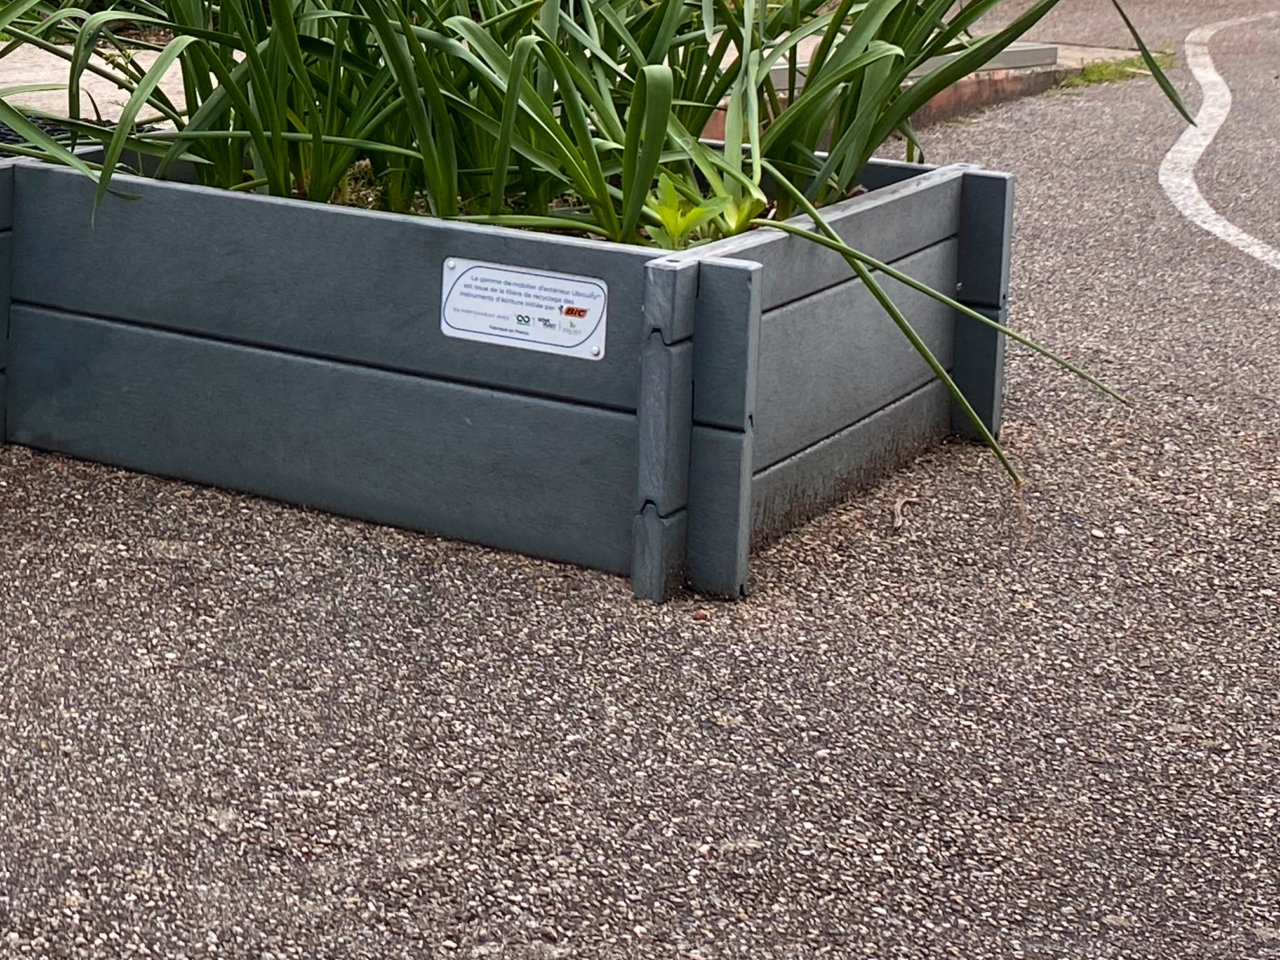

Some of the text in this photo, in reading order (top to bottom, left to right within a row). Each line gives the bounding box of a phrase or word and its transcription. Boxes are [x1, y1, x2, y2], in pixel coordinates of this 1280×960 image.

[480, 277, 502, 285] gamme
[512, 281, 536, 290] mobilier
[538, 285, 570, 296] d'extérieur
[460, 290, 494, 301] instruments
[496, 296, 524, 306] d'écriture
[526, 300, 543, 309] initiée
[533, 293, 562, 304] recyclage
[565, 306, 586, 316] BIC
